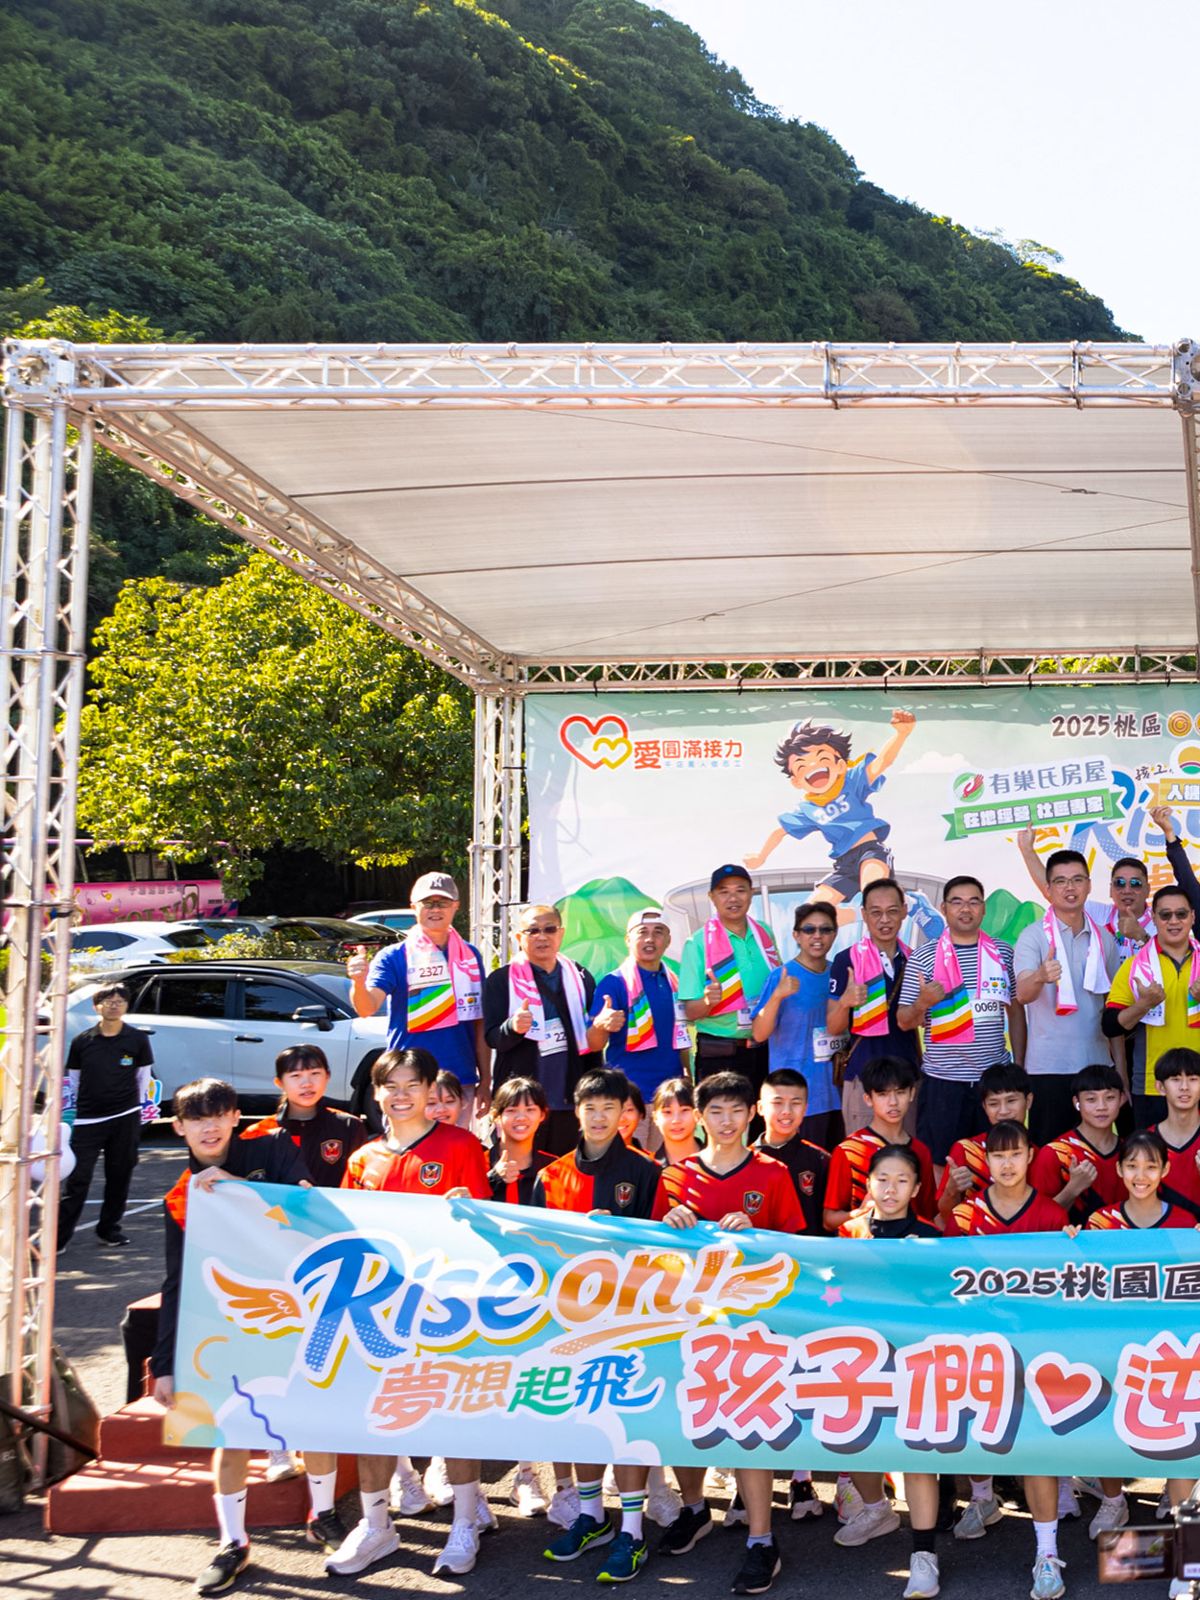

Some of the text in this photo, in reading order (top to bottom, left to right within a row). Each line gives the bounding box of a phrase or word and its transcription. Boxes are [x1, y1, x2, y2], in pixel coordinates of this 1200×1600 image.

[1052, 714, 1161, 737] 2025桃區
[634, 740, 742, 769] 愛圓滿接力
[989, 760, 1107, 795] 有巢氏房屋
[419, 965, 444, 978] 2327
[975, 1001, 998, 1012] 0069
[293, 1237, 729, 1374] Rise on!
[371, 1355, 664, 1431] 夢想起飛
[686, 1331, 1003, 1434] 孩子們
